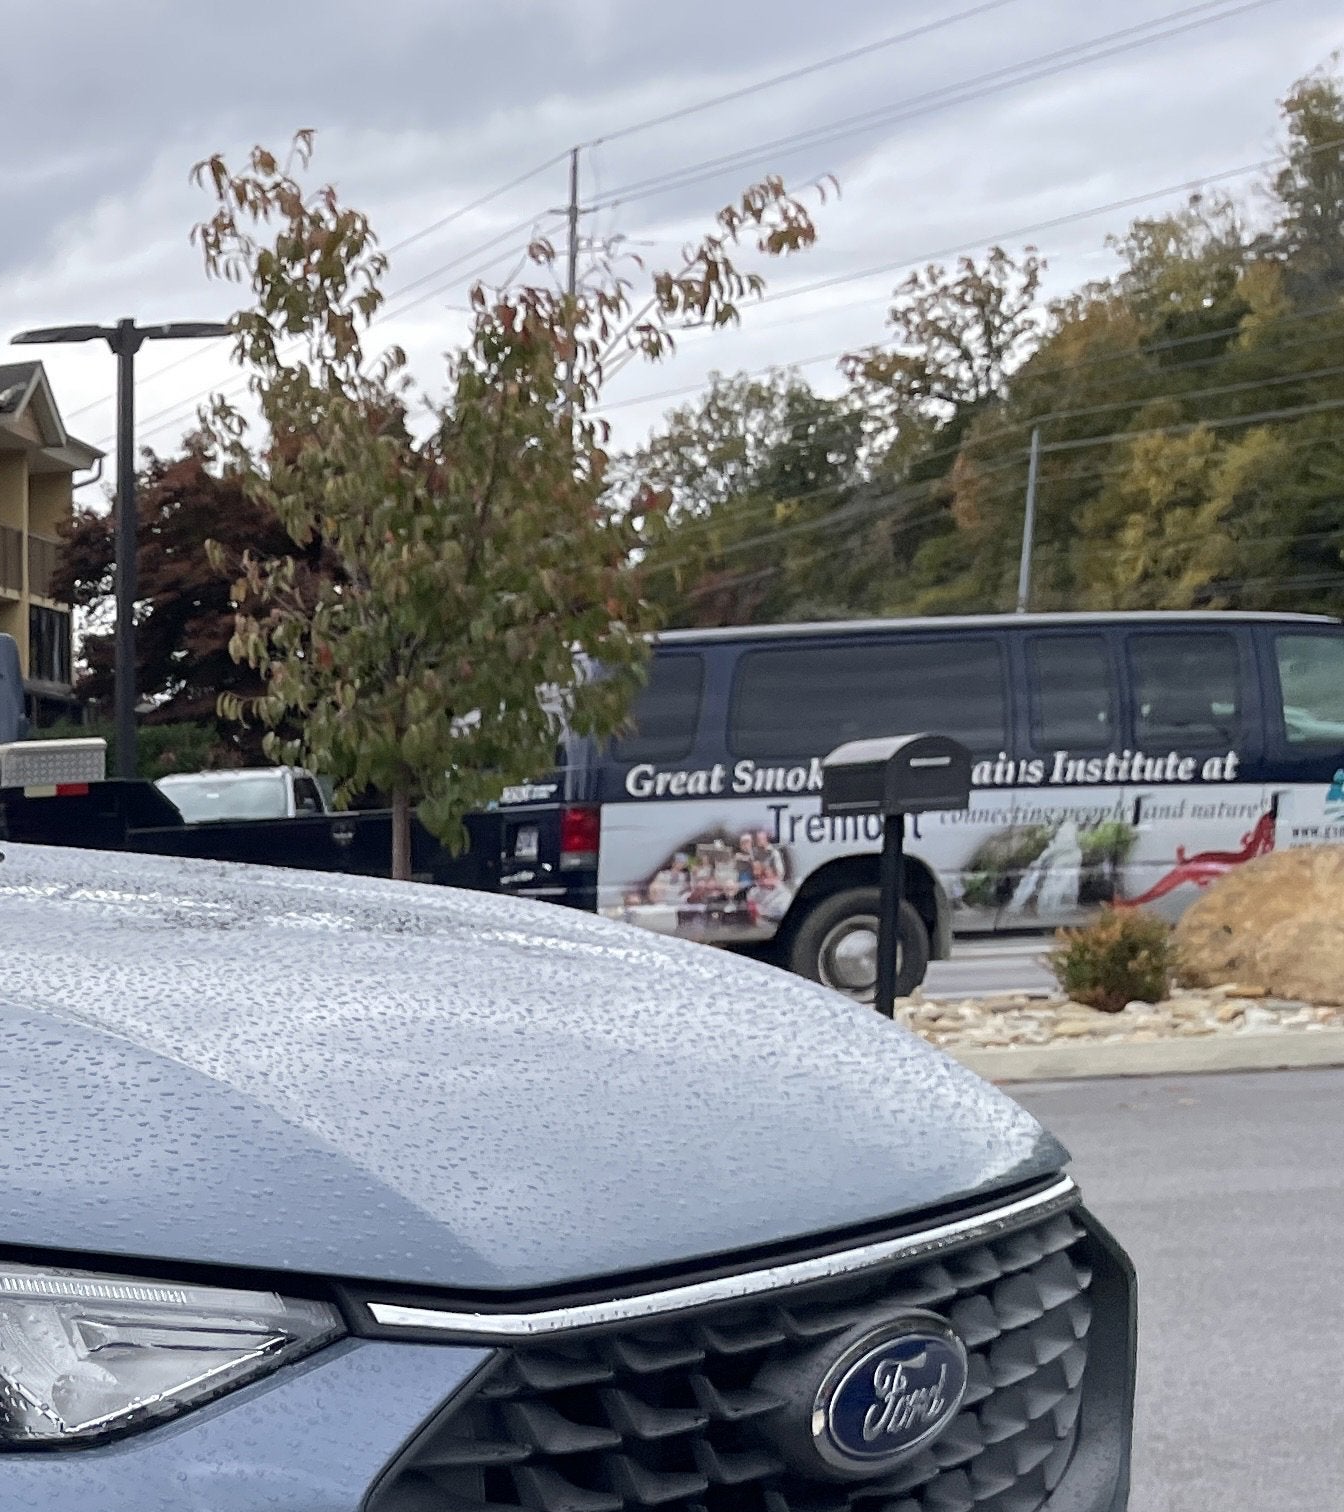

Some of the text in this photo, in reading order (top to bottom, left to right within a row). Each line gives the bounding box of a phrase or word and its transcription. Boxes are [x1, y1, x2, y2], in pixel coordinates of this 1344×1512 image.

[625, 763, 727, 797] Great
[732, 758, 824, 793] Smok
[1049, 749, 1197, 784] Institute
[1201, 750, 1240, 781] at
[767, 804, 922, 844] Tremot
[1143, 798, 1187, 819] and
[863, 1352, 947, 1441] Ford
